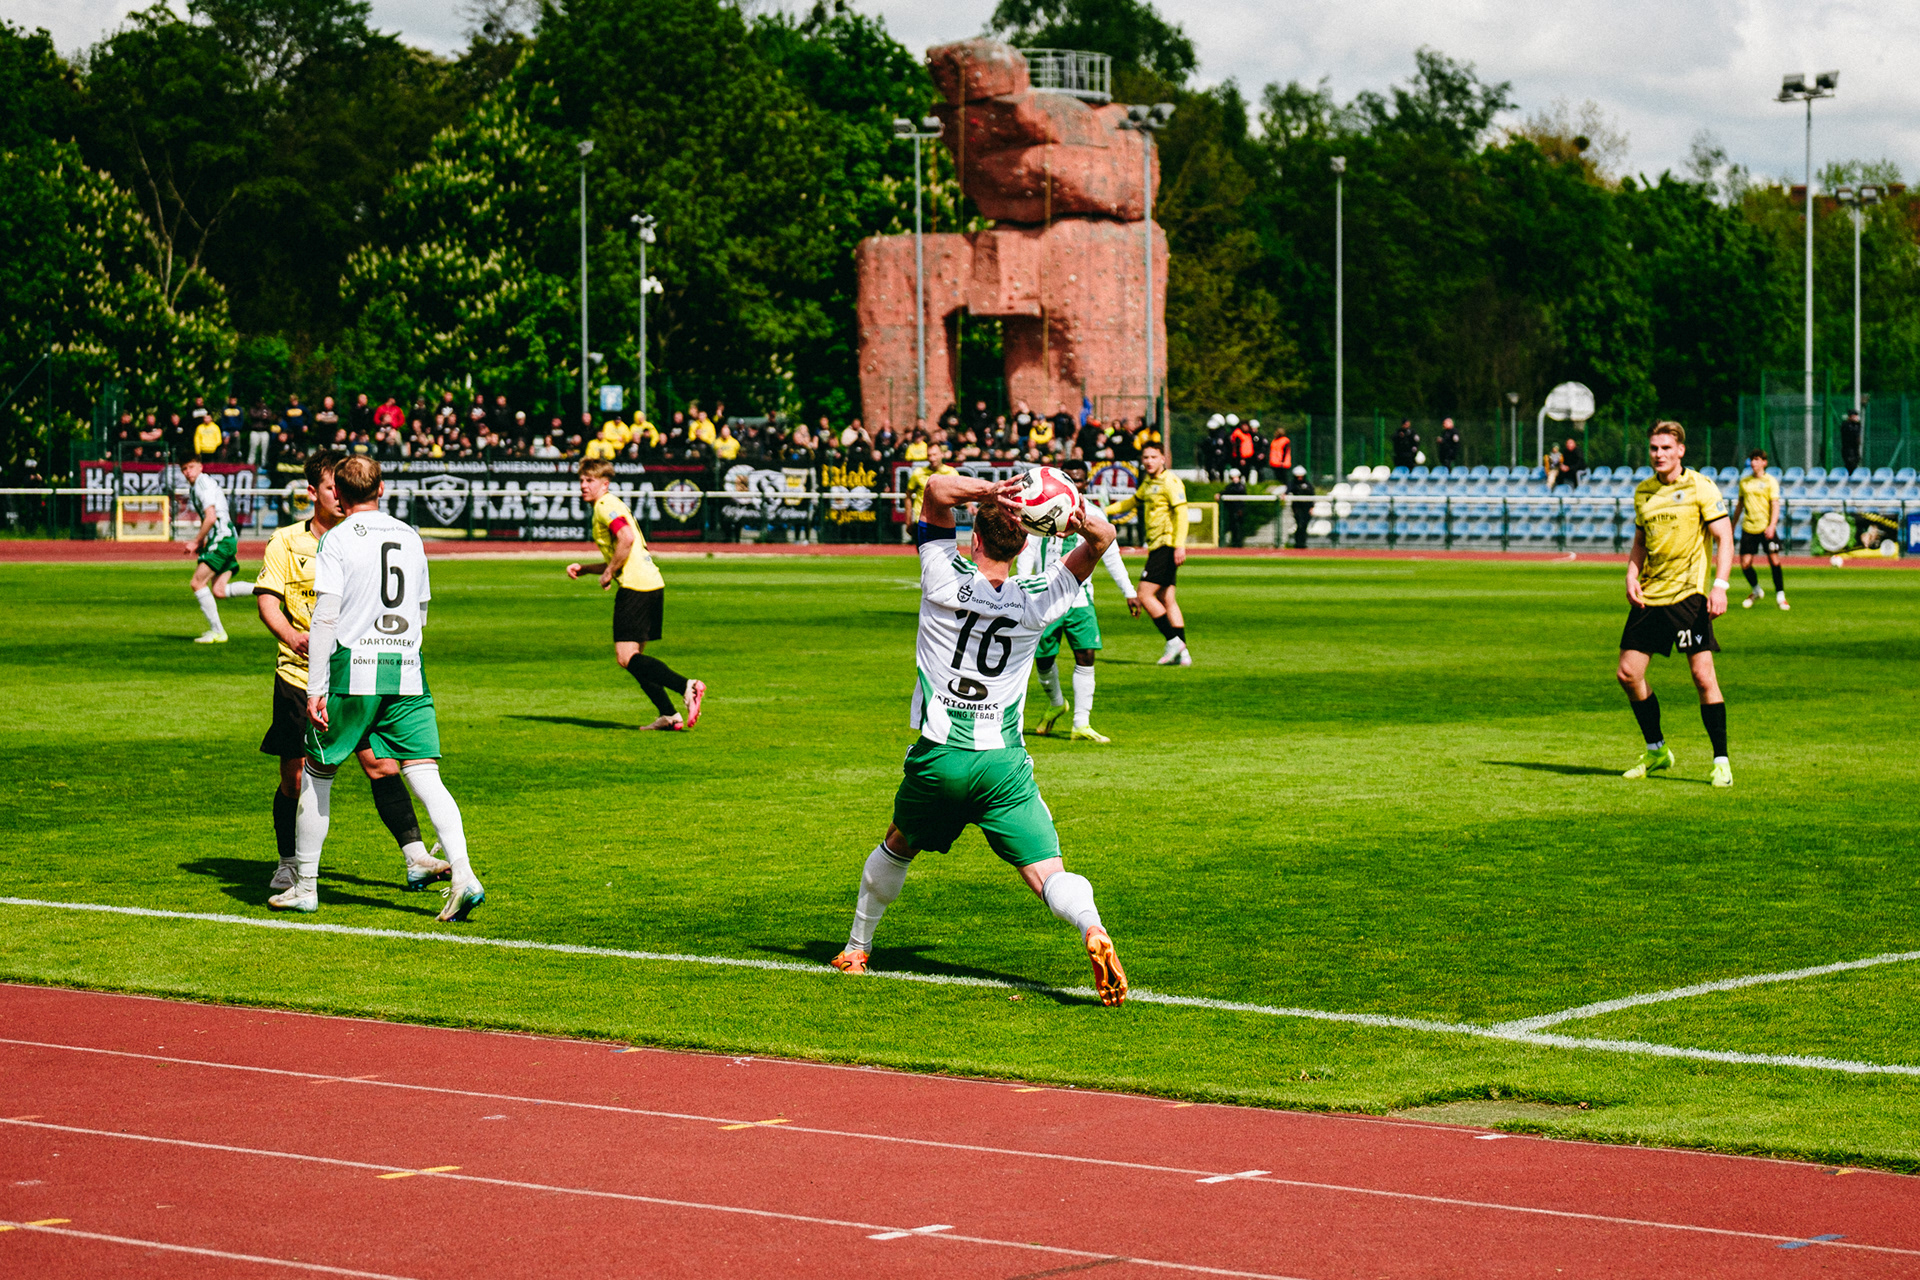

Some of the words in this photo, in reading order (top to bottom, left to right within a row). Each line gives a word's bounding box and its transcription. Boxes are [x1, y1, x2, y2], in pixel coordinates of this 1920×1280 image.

[379, 462, 403, 473] KIPY
[448, 462, 488, 474] BANDA
[381, 542, 405, 609] 6
[951, 609, 1019, 678] 16
[1677, 629, 1692, 648] 21
[969, 711, 994, 720] KEBAB
